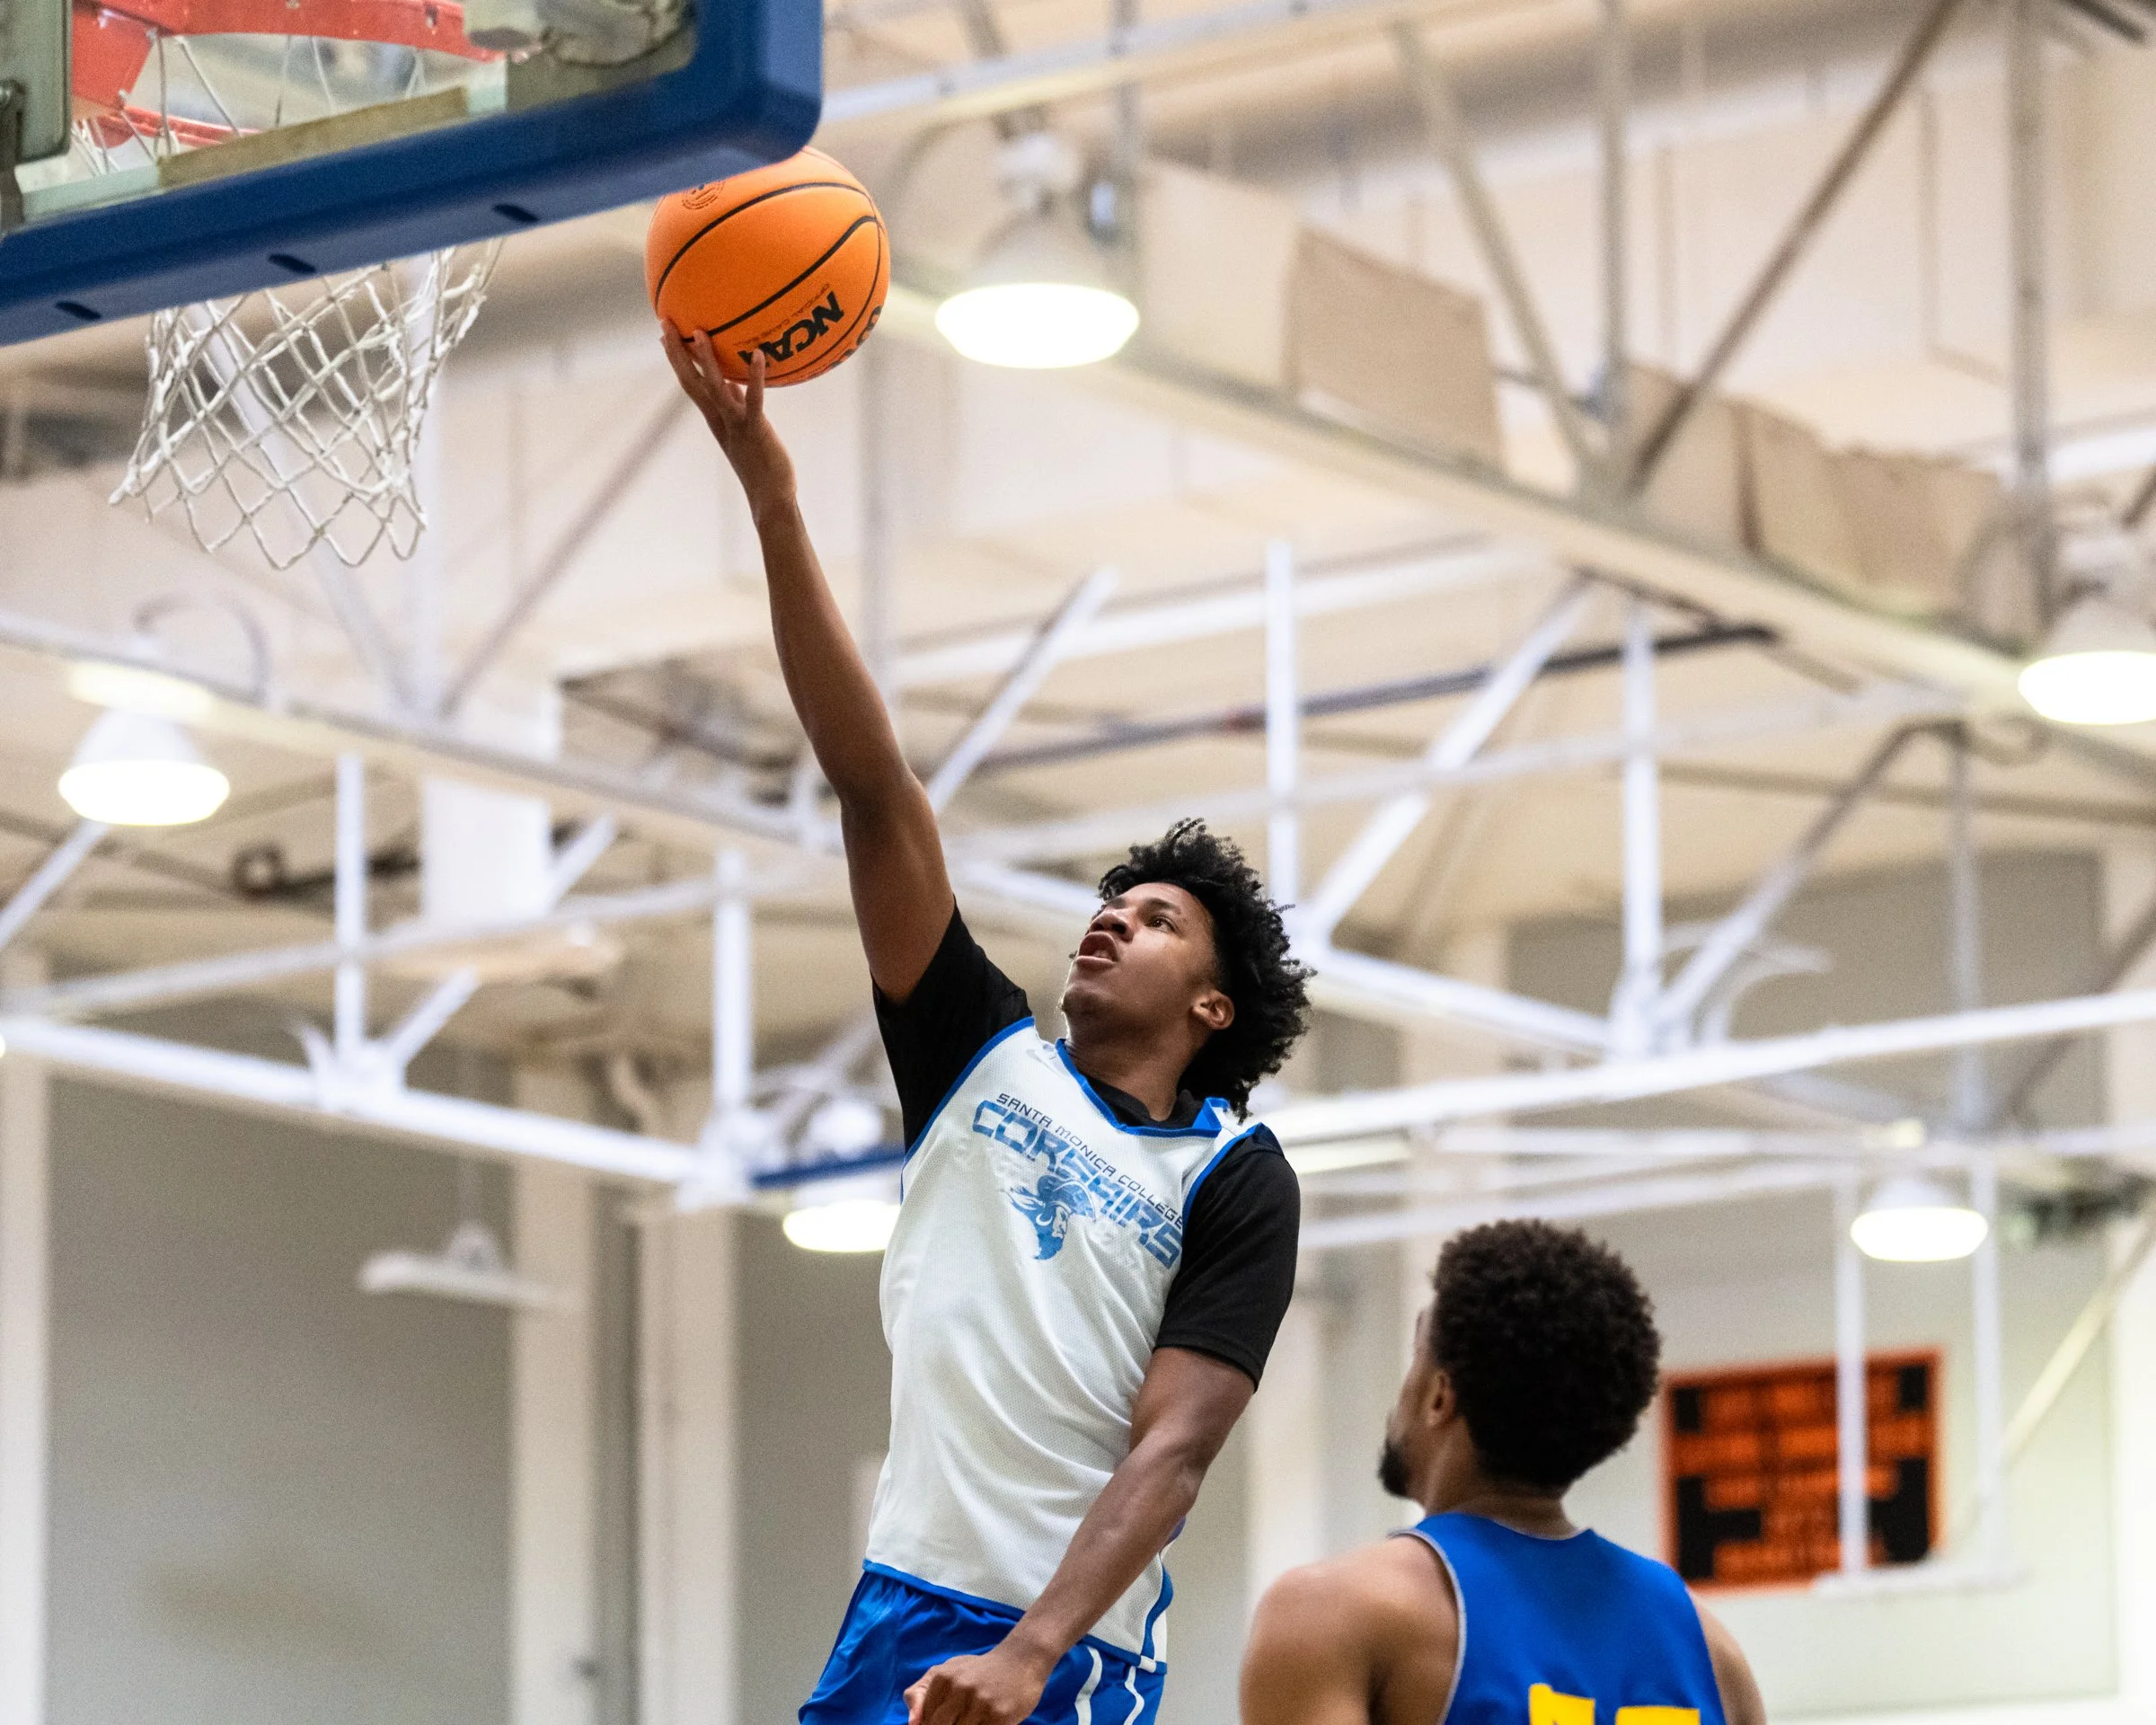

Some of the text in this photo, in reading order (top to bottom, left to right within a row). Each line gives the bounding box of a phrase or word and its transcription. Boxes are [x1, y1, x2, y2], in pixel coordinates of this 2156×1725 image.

[973, 1100, 1183, 1269] CORSAIRS
[996, 1092, 1183, 1230] SANTA MONICA COLLEGE
